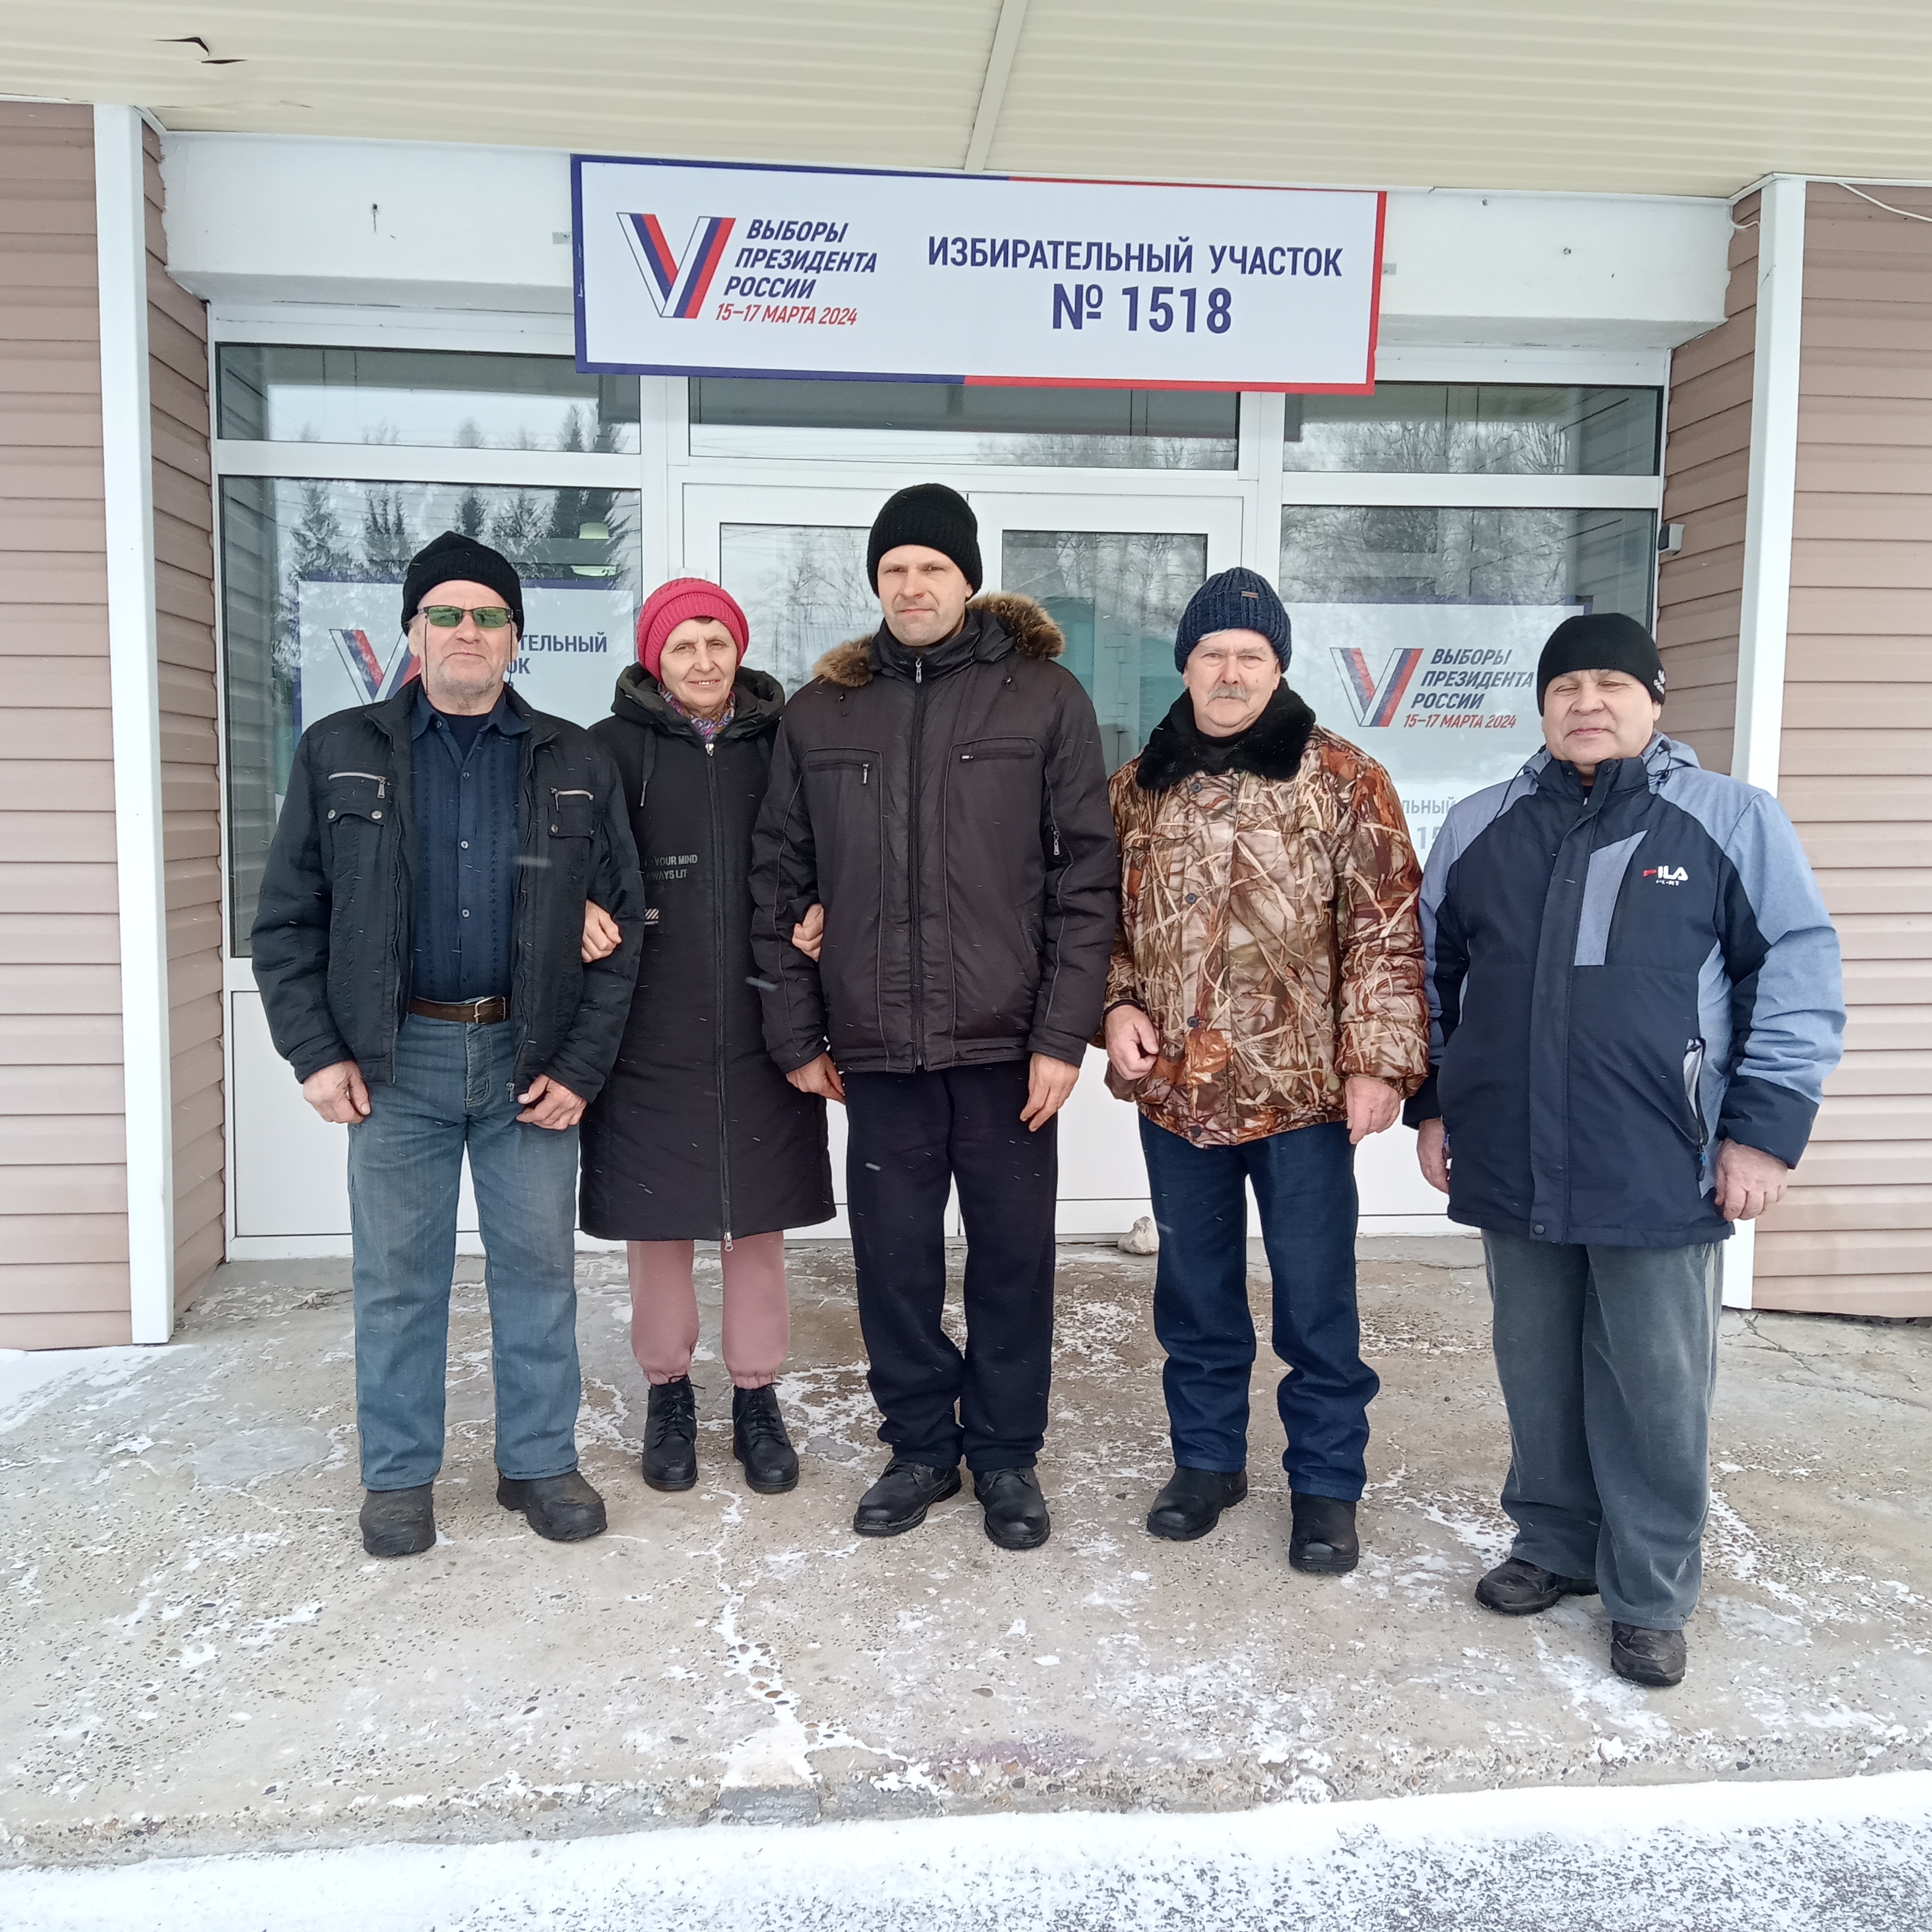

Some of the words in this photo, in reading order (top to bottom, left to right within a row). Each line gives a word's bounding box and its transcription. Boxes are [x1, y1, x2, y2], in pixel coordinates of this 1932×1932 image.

[746, 219, 849, 243] ВЫБОРЫ
[734, 248, 877, 274] ПРЕЗИДЕНТА
[928, 236, 1193, 274] ИЗБИРАТЕЛЬНЫЙ
[1209, 245, 1343, 277] УЧАСТОК
[723, 276, 816, 299] РОССИИ
[762, 305, 816, 325] МАРТА
[817, 307, 857, 326] 2024
[1053, 283, 1103, 330] №
[1122, 285, 1232, 334] 1518
[520, 632, 607, 653] ТЕЛЬНЫЙ
[1430, 648, 1513, 665] ВЫБОРЫ
[1421, 671, 1535, 690] ПРЕЗИДЕНТА
[1411, 692, 1486, 709] РОССИИ
[1439, 714, 1484, 728] МАРТА
[1484, 714, 1516, 729] 2024
[653, 856, 677, 866] YOUR
[678, 854, 698, 865] MIND
